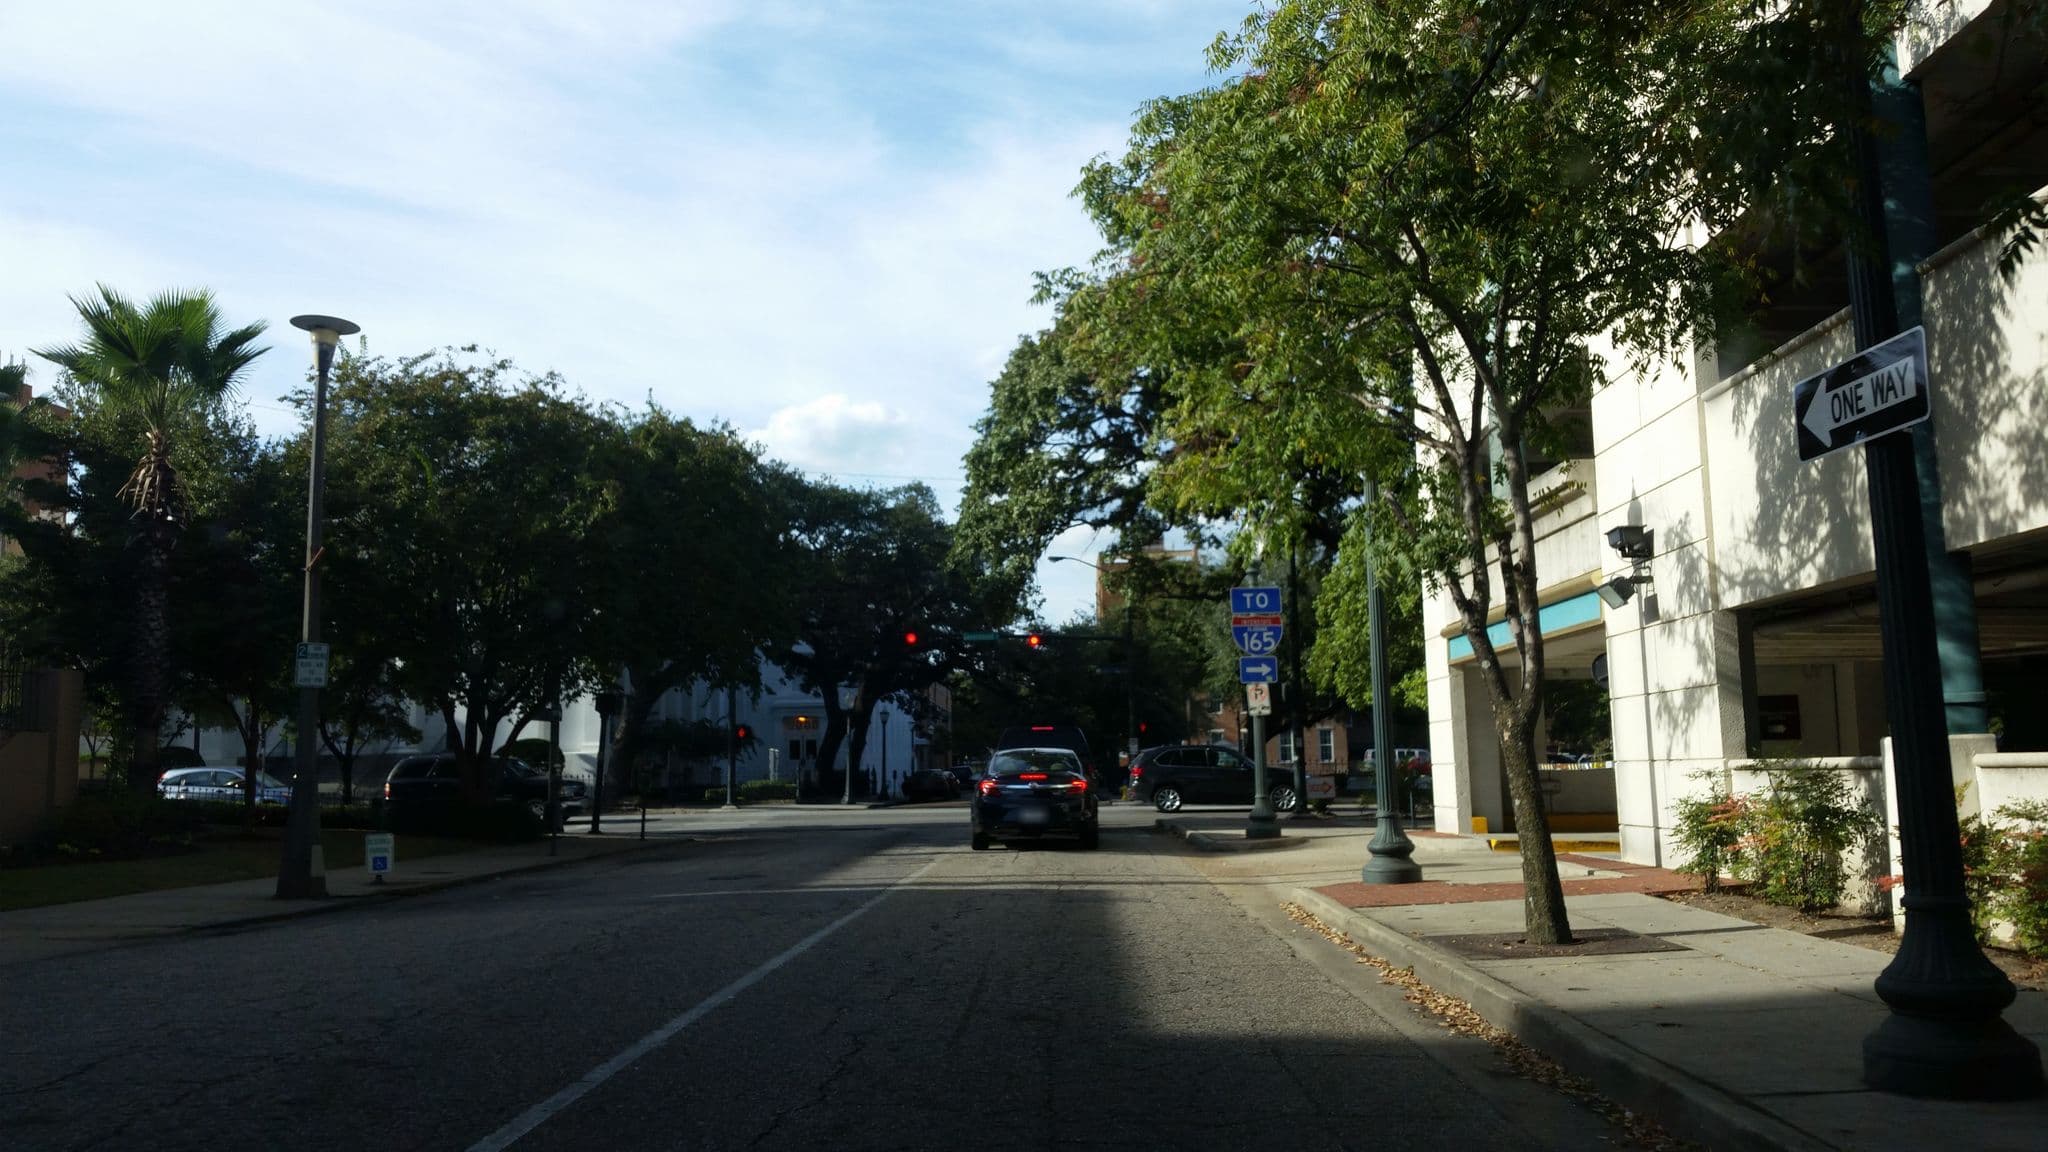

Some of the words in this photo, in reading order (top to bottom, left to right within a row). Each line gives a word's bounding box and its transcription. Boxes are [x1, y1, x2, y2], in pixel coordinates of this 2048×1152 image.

[1831, 382, 1866, 423] ONE
[1871, 363, 1909, 407] WAY
[1242, 592, 1269, 608] TO
[1243, 631, 1275, 652] 165
[299, 645, 306, 657] 2
